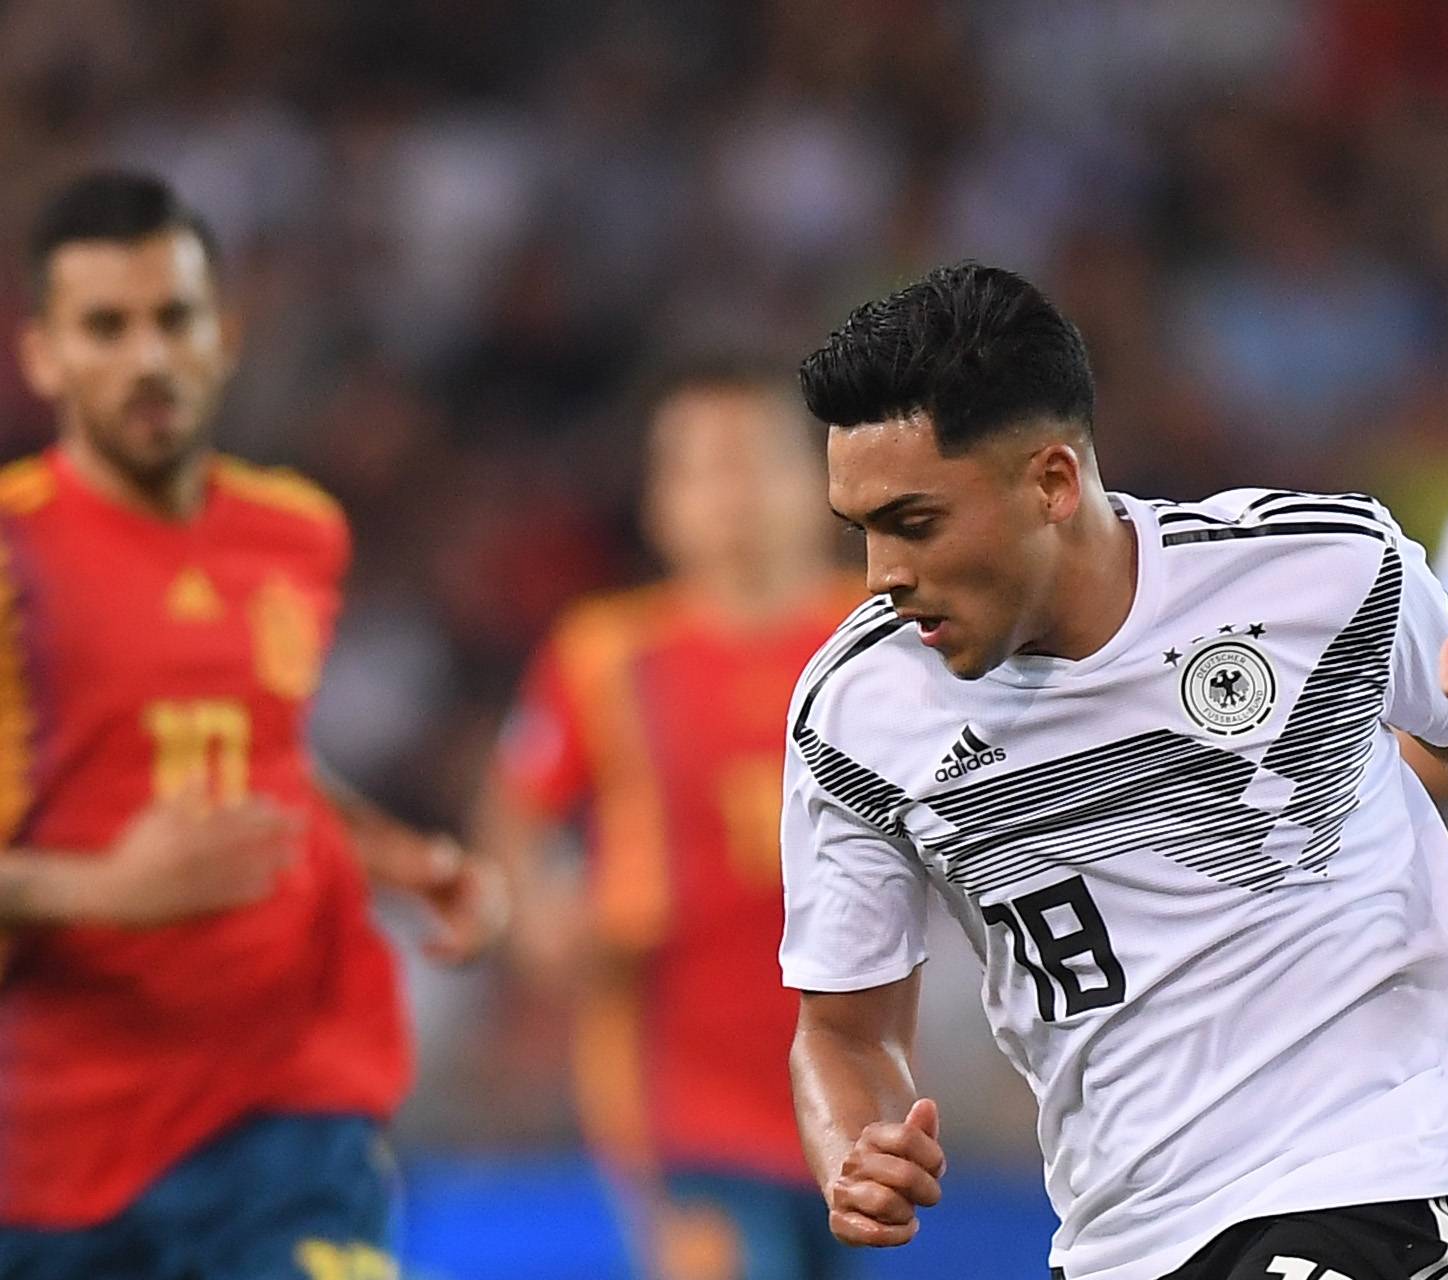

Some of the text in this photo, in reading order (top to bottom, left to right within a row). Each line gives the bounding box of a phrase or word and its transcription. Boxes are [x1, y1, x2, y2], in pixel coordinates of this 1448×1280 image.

[1196, 653, 1247, 679] DEUTSCHER
[935, 747, 1007, 783] adidas
[980, 873, 1127, 1022] 18
